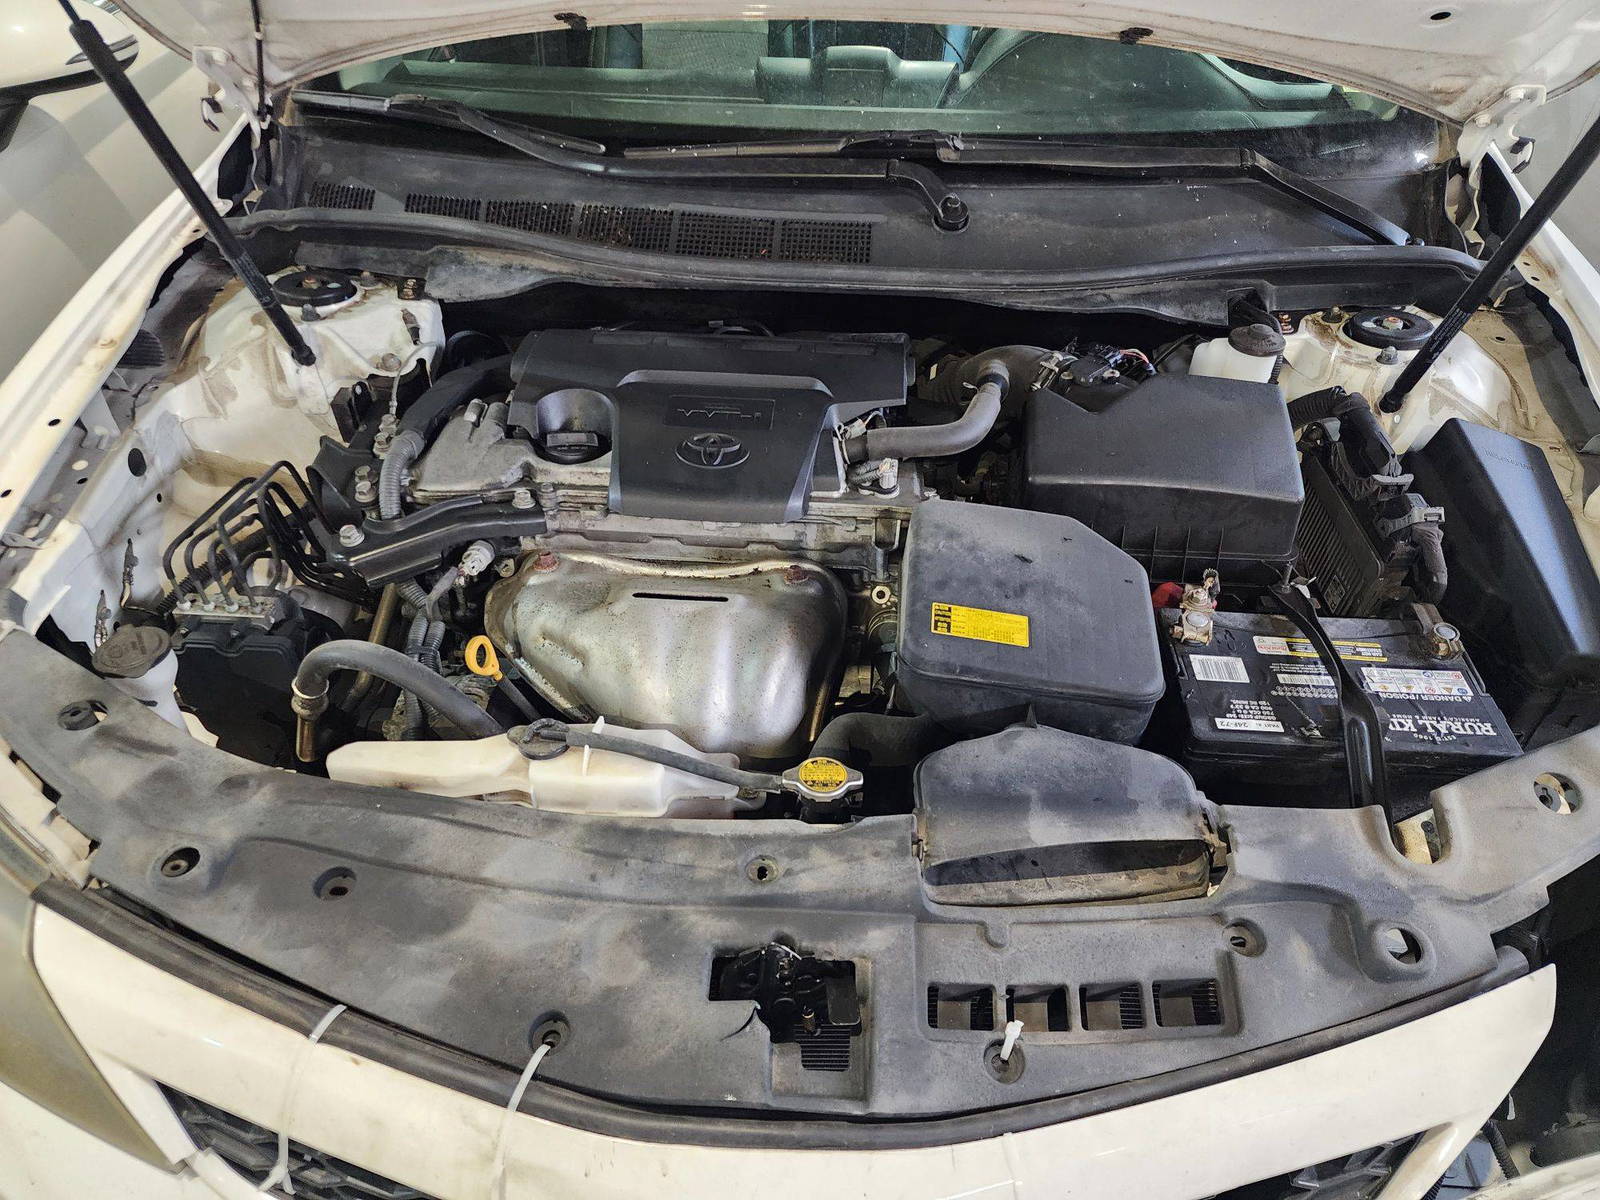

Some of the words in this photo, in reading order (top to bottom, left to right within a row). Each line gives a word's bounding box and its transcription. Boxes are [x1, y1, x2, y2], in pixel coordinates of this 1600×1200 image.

[1378, 691, 1415, 700] POISON
[1420, 694, 1463, 702] DANGER
[1219, 720, 1249, 728] 24F-72
[1417, 719, 1497, 736] RURAL
